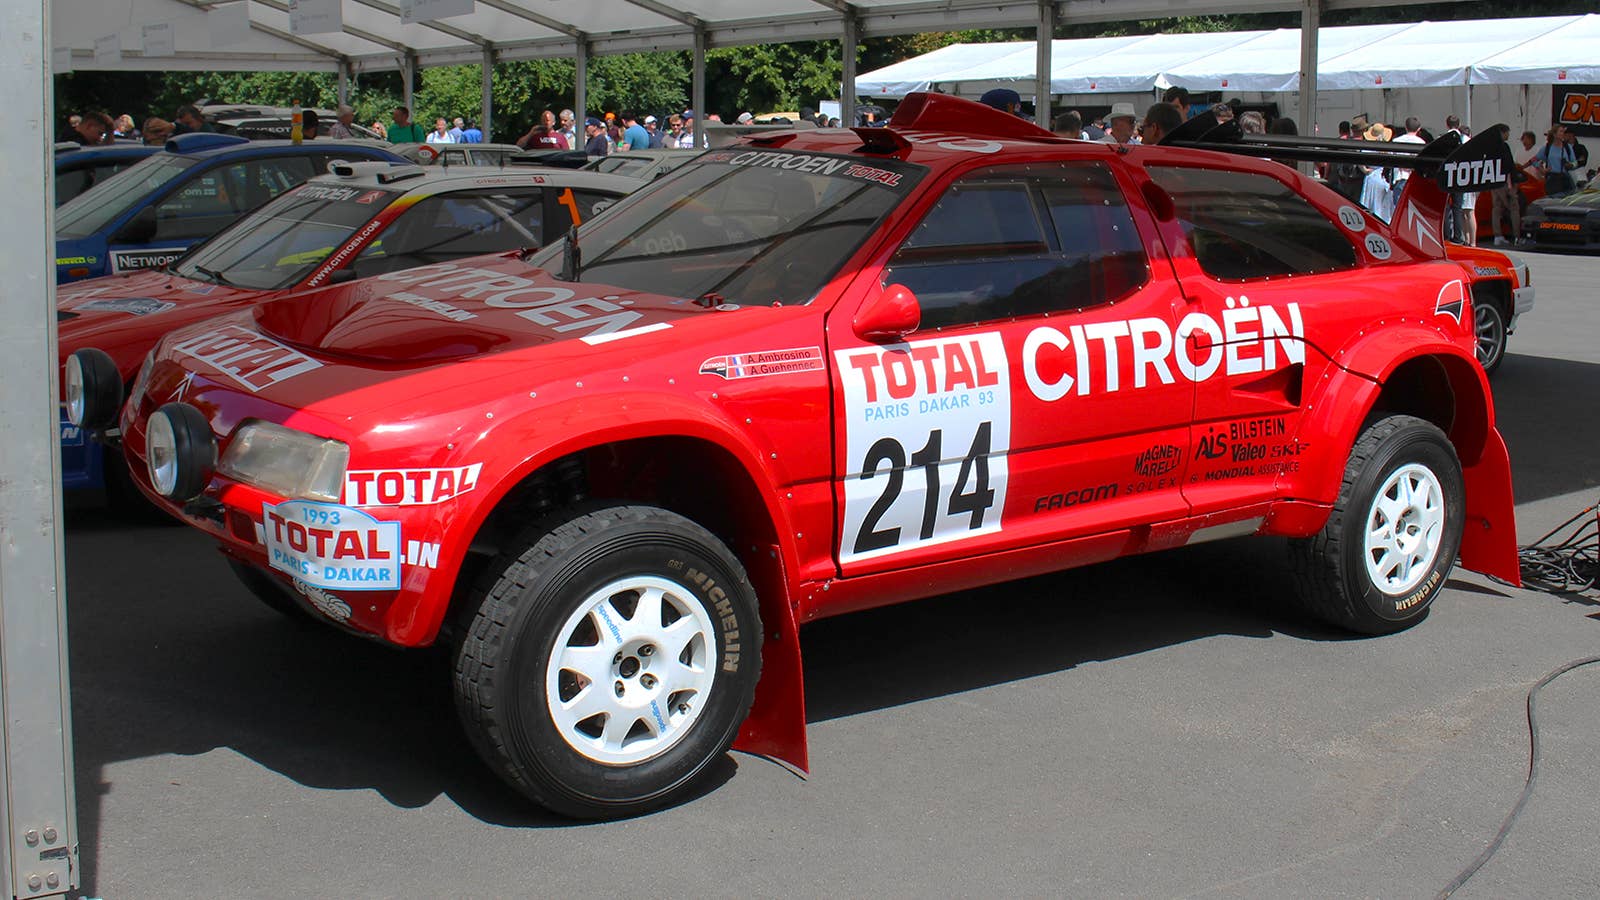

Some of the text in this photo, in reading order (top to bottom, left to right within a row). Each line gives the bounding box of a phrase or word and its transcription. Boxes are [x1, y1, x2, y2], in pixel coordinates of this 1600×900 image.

[843, 164, 903, 187] TOTAL
[1445, 158, 1506, 187] TOTAL
[558, 187, 582, 227] 1
[1341, 212, 1362, 225] 212
[119, 255, 182, 267] NETWOR
[1369, 240, 1389, 253] 252
[379, 265, 673, 345] CITROËN
[180, 325, 312, 390] TOTAL
[1022, 295, 1306, 402] CITROËN
[849, 340, 999, 403] TOTAL
[865, 391, 994, 422] PARIS DAKAR 93
[1230, 417, 1285, 440] BILSTEIN
[1231, 442, 1266, 462] Valeo
[349, 468, 474, 504] TOTAL
[1126, 478, 1177, 494] SOLEX
[1205, 462, 1299, 480] MONDIAL ASSISTANCE
[853, 420, 995, 554] 214
[1034, 483, 1118, 512] FACOM
[302, 508, 341, 525] 1993
[269, 511, 390, 560] TOTAL
[274, 548, 309, 575] PARIS
[324, 566, 390, 581] DAKAR
[401, 540, 440, 569] IN
[1395, 570, 1440, 611] MICHELIN
[598, 604, 623, 643] speedline
[685, 567, 740, 672] MICHELIN
